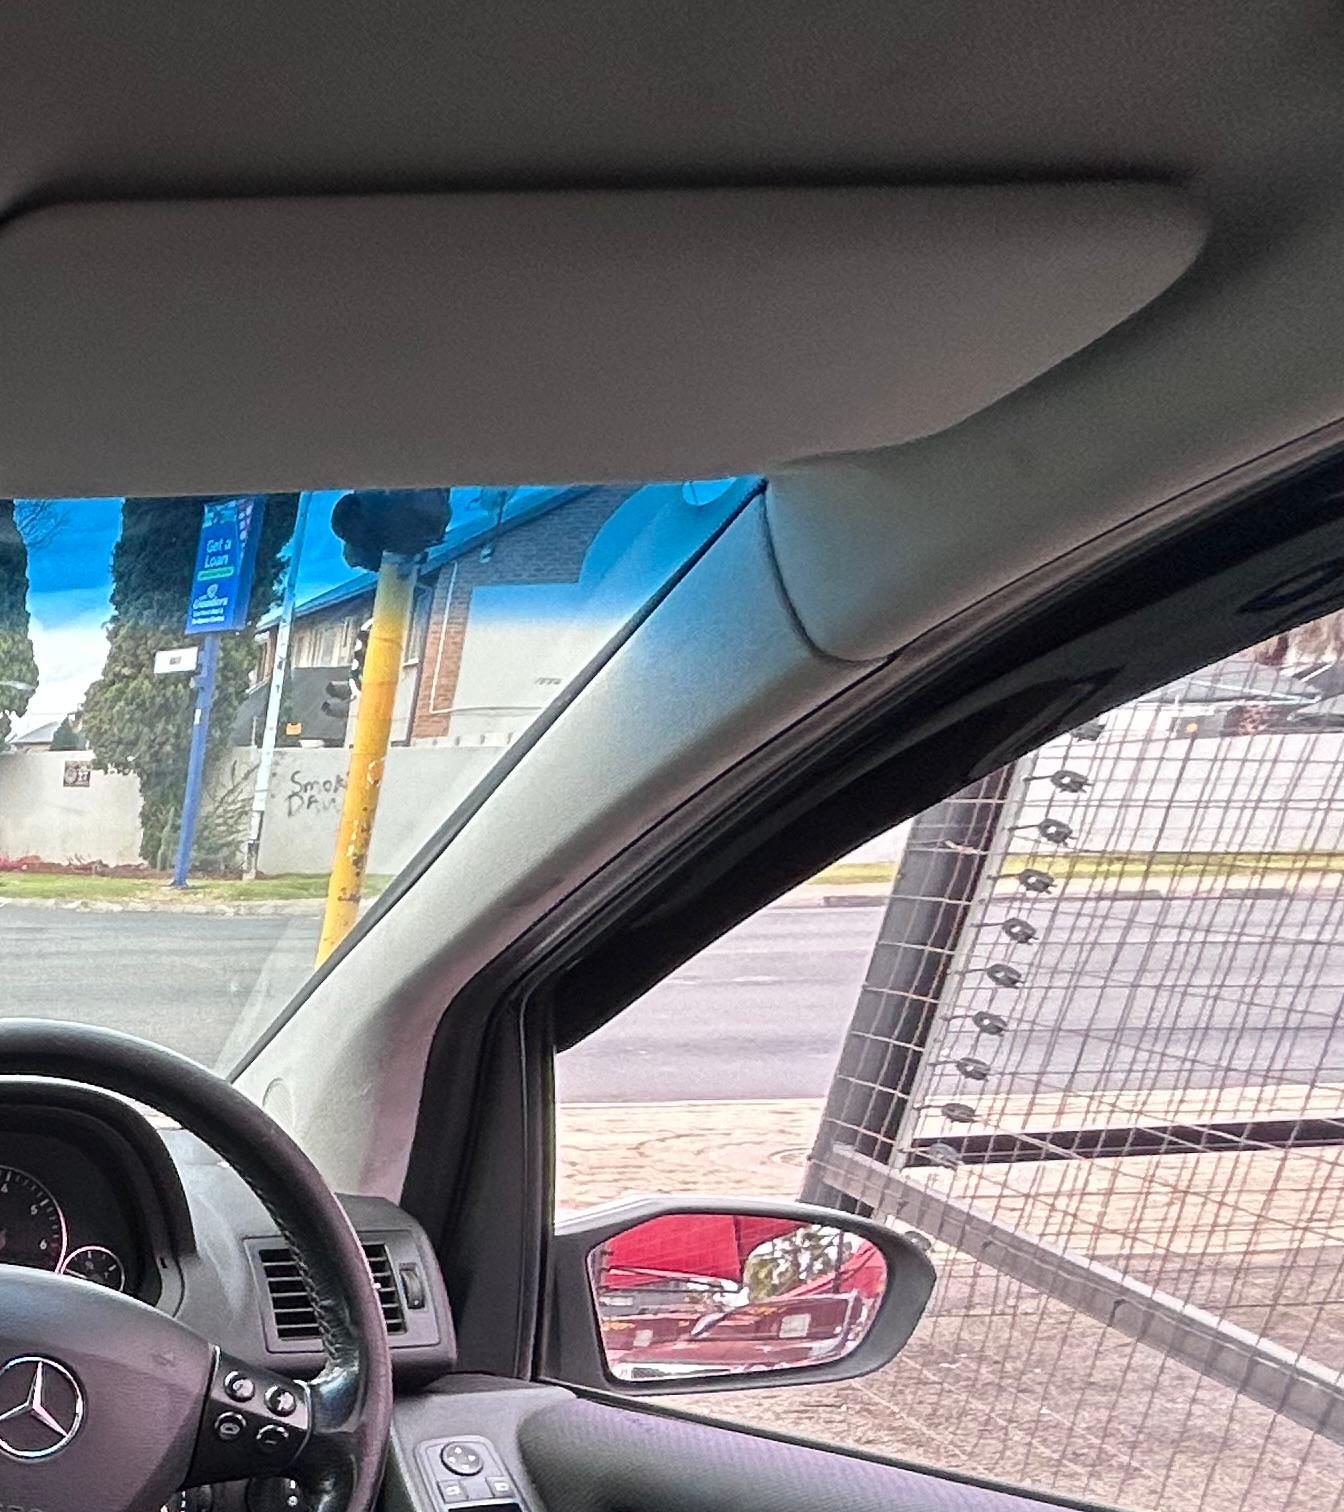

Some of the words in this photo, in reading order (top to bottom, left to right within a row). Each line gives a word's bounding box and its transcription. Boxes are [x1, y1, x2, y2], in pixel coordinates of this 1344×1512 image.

[204, 554, 229, 568] Loan
[0, 1182, 9, 1193] 4
[30, 1204, 38, 1215] 5
[39, 1239, 48, 1250] 6
